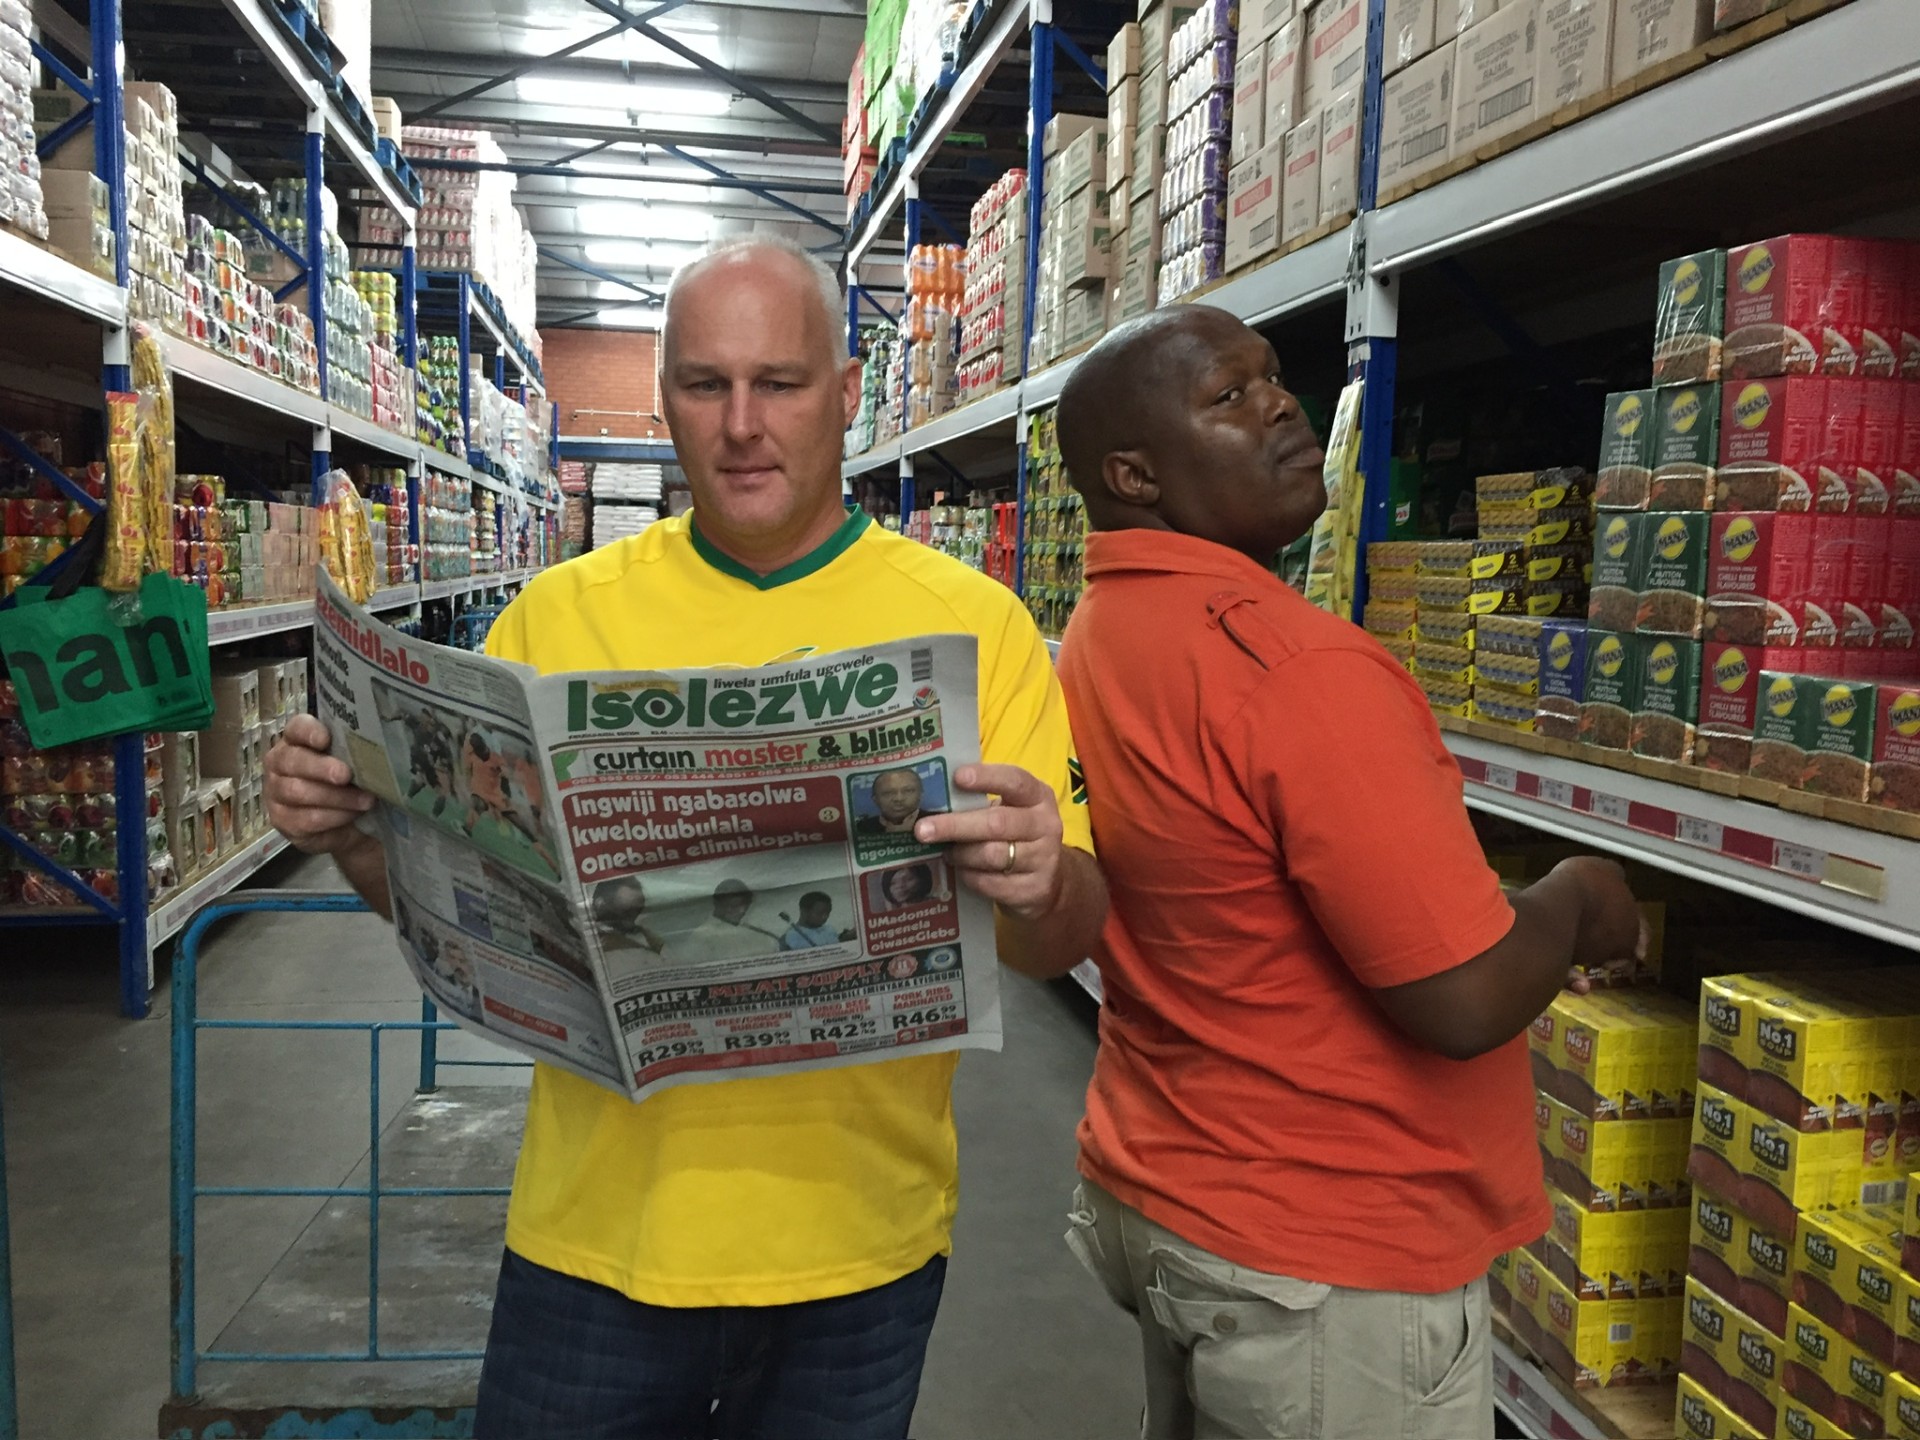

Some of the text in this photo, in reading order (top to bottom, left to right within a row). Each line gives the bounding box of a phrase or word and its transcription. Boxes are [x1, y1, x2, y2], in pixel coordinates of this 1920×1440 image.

[1571, 485, 1579, 496] 2
[1509, 553, 1517, 565] 2
[1508, 592, 1516, 603] 2
[713, 654, 874, 689] liwela umfula ugcwele
[567, 662, 899, 732] Isolezwe
[593, 746, 696, 771] curtain
[704, 741, 809, 768] master
[817, 735, 843, 758] &
[849, 715, 936, 755] blinds
[572, 784, 808, 818] Ingwiji ngabasolwa
[822, 808, 835, 822] 3
[572, 814, 754, 848] kwelokubulala
[581, 846, 680, 875] onebala
[686, 830, 824, 858] elimhlophe
[868, 903, 949, 929] UMadonsela
[870, 920, 931, 941] ungenela
[871, 926, 956, 952] olwaseGlebe
[618, 988, 702, 1015] BLUFF
[707, 976, 793, 999] MEAT
[796, 960, 884, 989] SUPPLY
[893, 990, 922, 1003] PORK
[892, 1008, 941, 1030] R46
[1707, 998, 1737, 1025] No.1
[725, 1032, 774, 1051] R39
[810, 1024, 859, 1042] R42
[1566, 1030, 1591, 1053] No.1
[1760, 1021, 1793, 1050] No.1
[638, 1041, 687, 1068] R29
[1703, 1099, 1732, 1128] No.1
[1753, 1127, 1786, 1156] No.1
[1700, 1201, 1730, 1231] No.1
[1750, 1231, 1784, 1265] No.1
